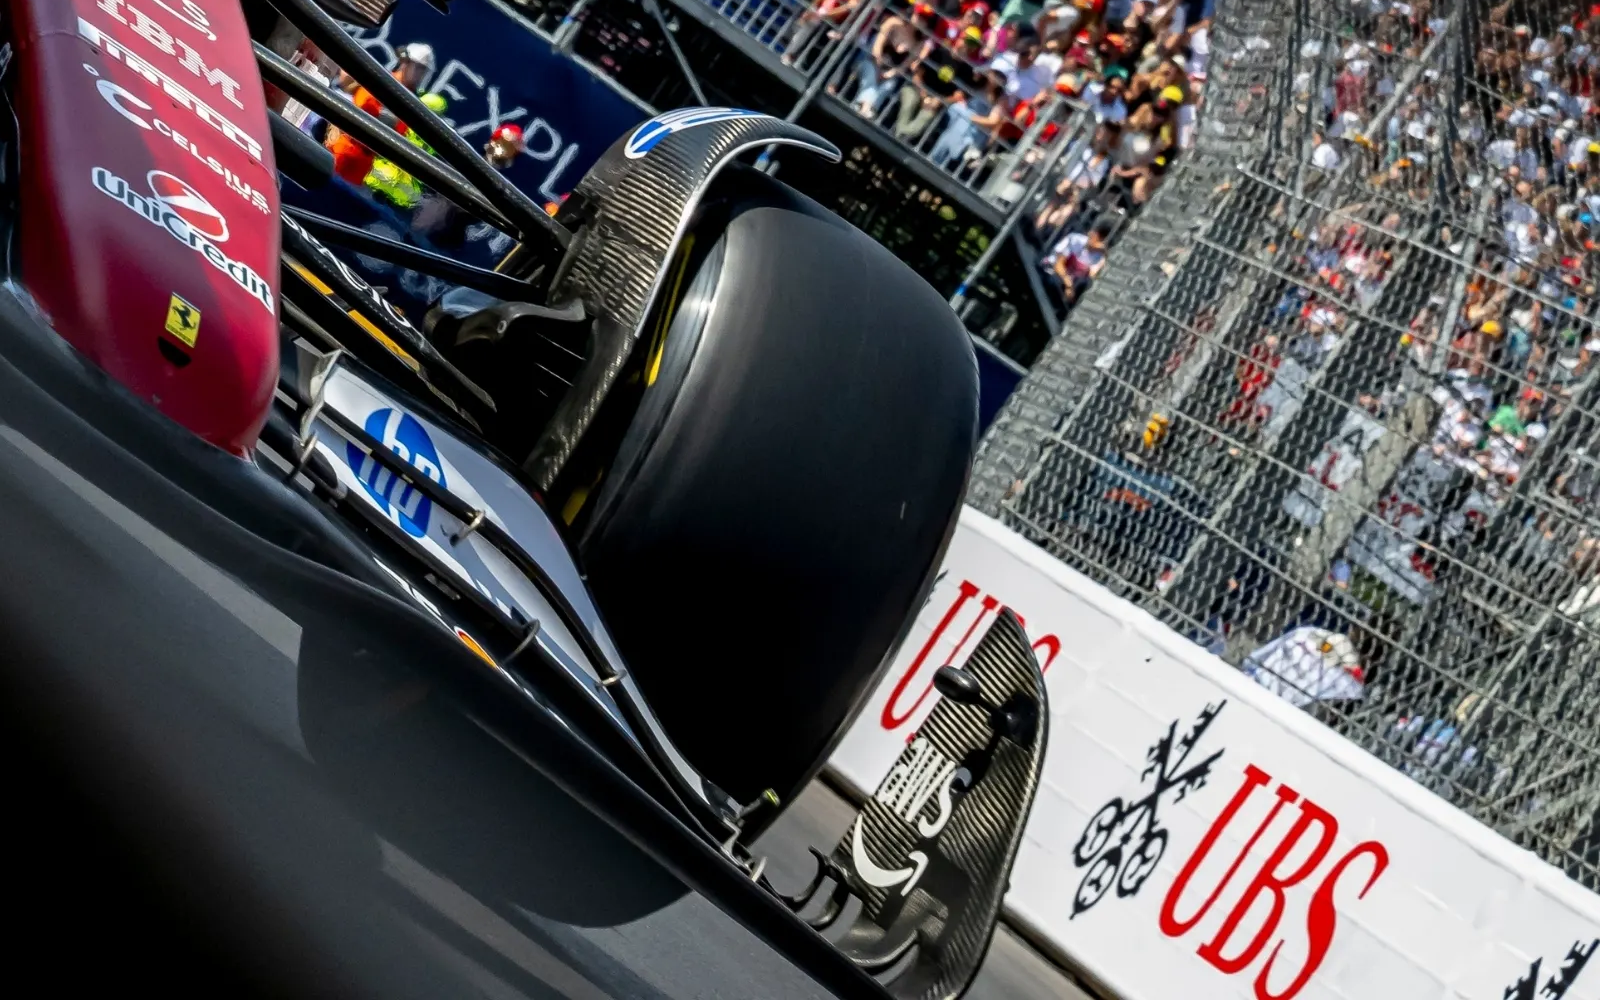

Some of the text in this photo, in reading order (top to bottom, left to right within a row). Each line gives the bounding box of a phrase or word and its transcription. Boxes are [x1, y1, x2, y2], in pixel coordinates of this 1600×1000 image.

[77, 16, 263, 161] PIRELLI
[426, 58, 580, 201] EXPL
[153, 118, 269, 210] CELSIUS
[93, 167, 274, 309] UniCredit
[353, 409, 445, 531] hp
[1158, 762, 1390, 1000] UBS
